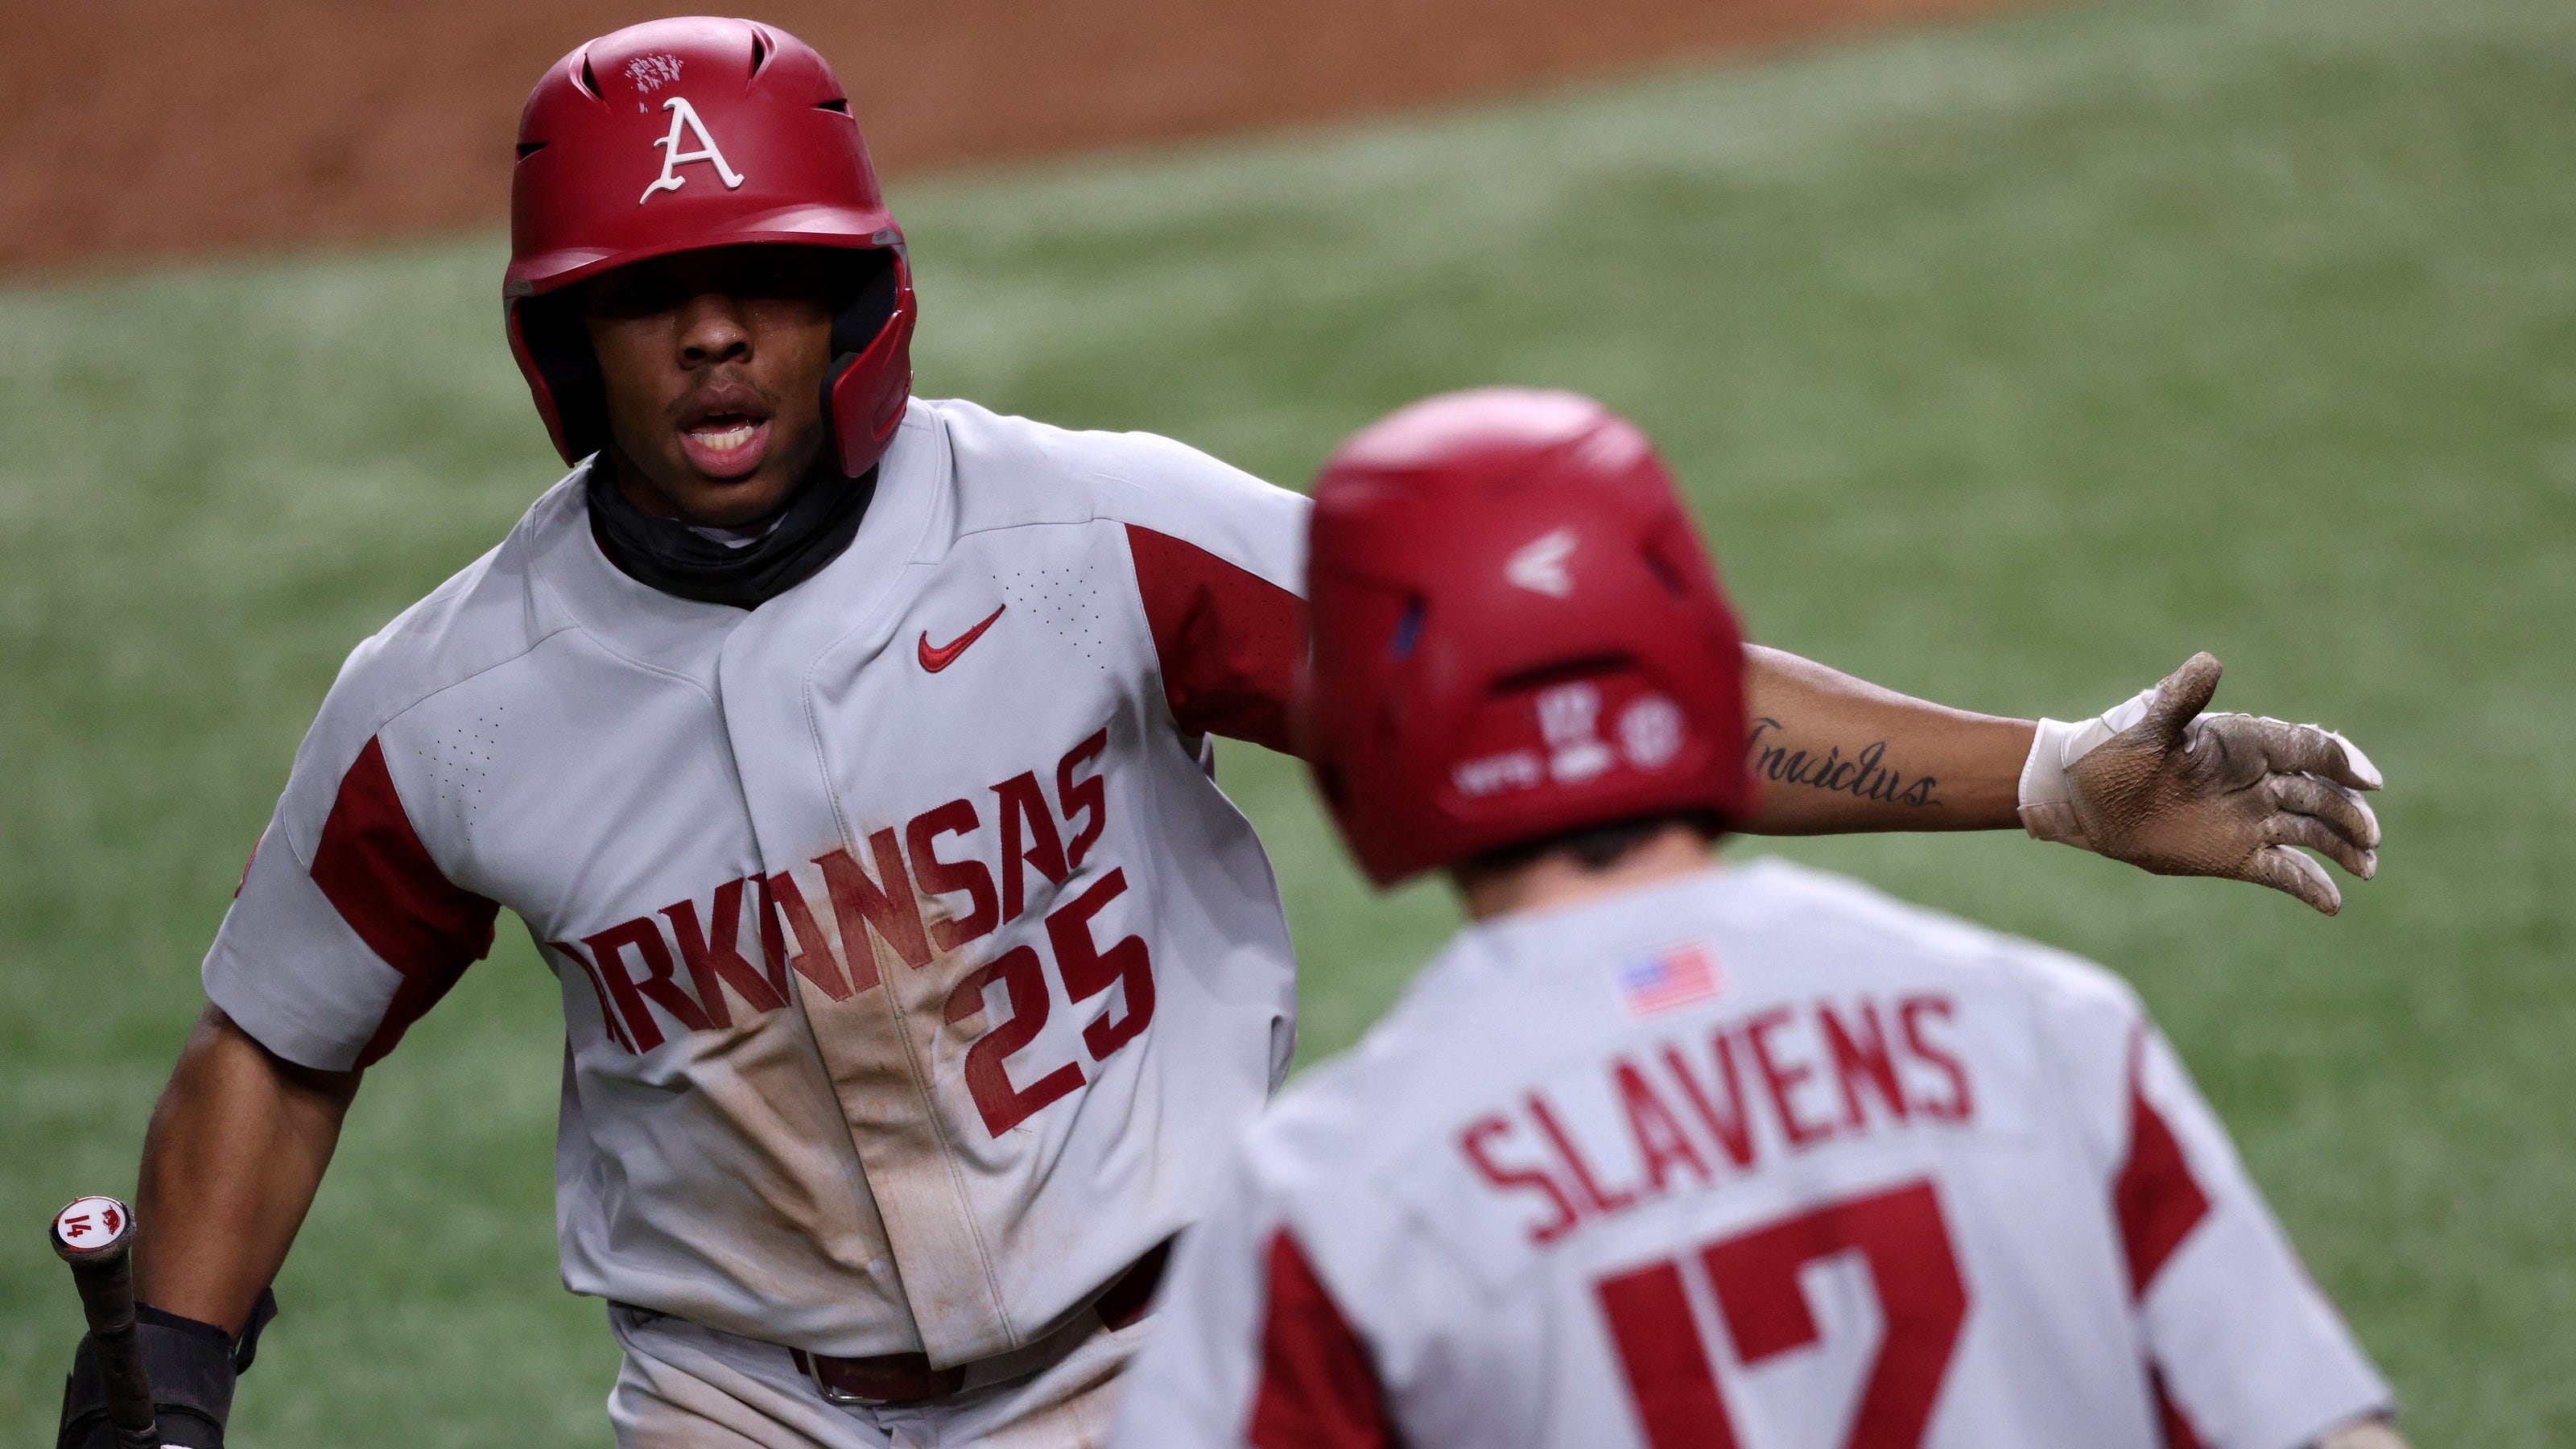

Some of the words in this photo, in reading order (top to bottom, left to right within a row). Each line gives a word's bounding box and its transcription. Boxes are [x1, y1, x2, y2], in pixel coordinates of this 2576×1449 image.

[639, 97, 745, 204] A
[1742, 717, 1943, 806] Invictus
[944, 866, 1155, 1138] 25
[1458, 991, 1974, 1245] SLAVENS
[65, 1215, 92, 1237] 14
[1589, 1178, 1969, 1449] 17
